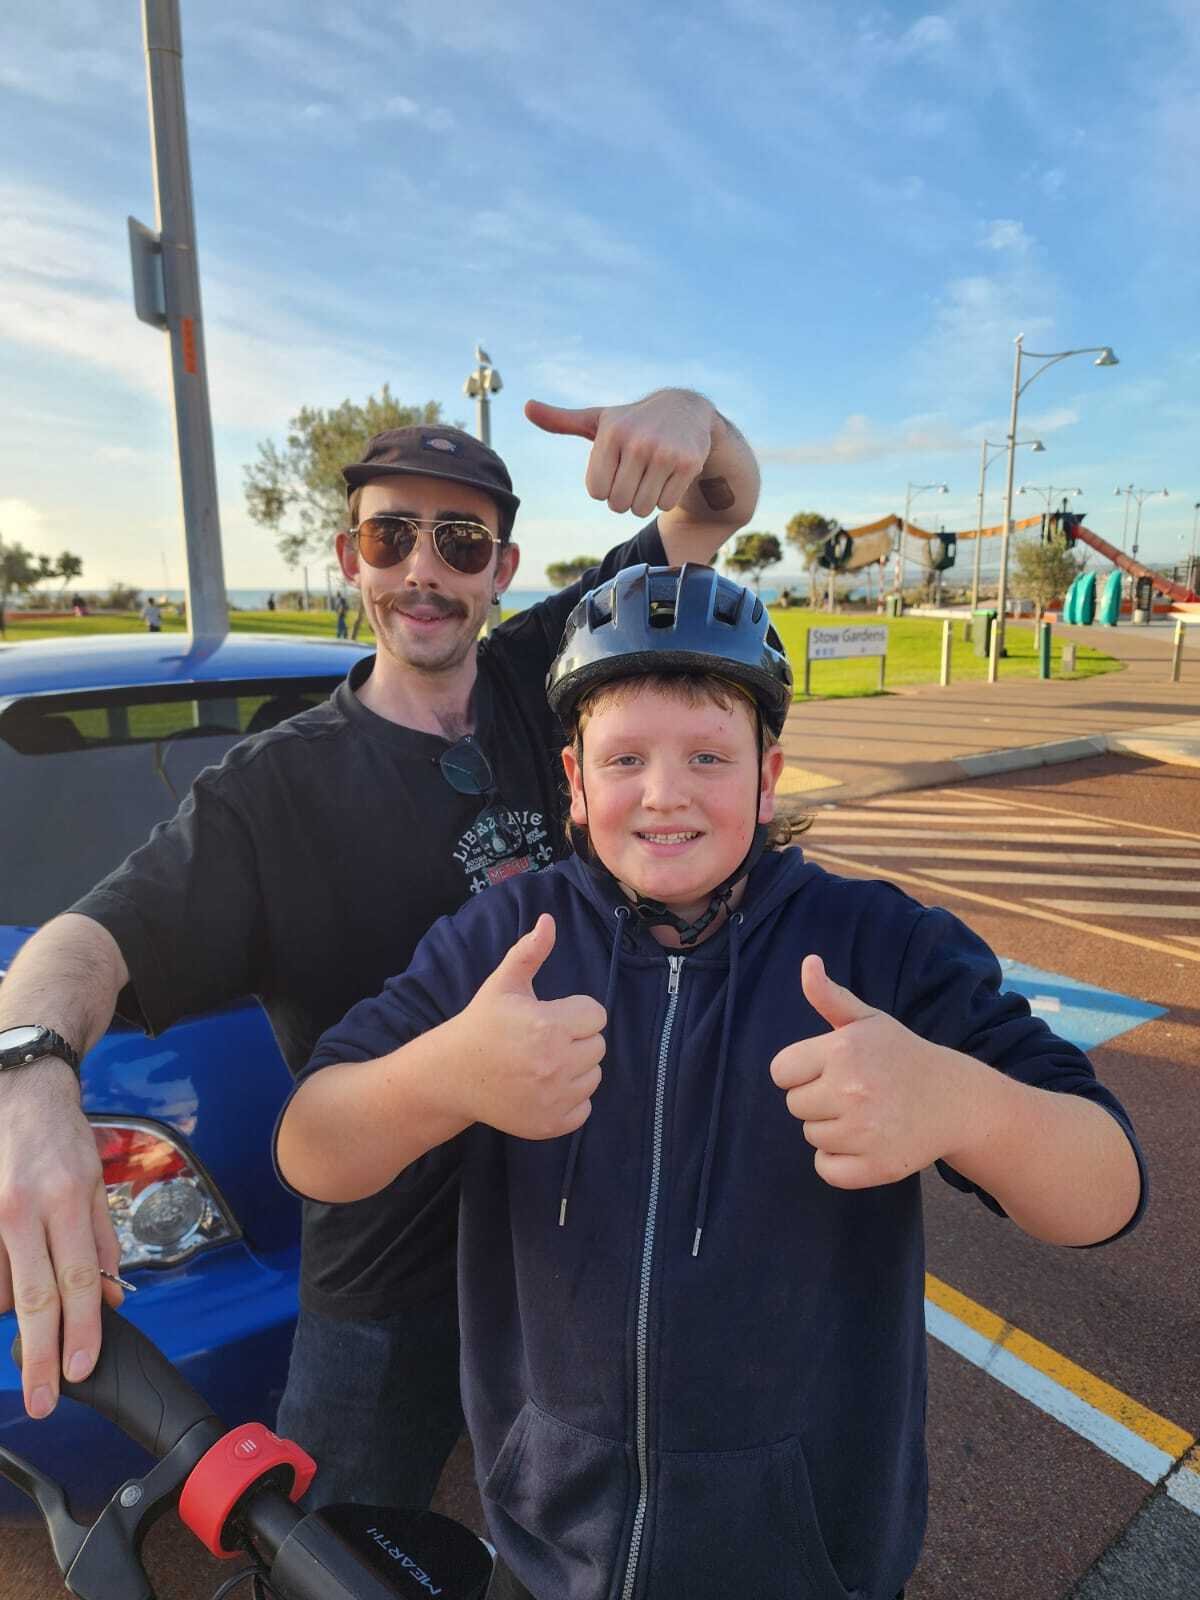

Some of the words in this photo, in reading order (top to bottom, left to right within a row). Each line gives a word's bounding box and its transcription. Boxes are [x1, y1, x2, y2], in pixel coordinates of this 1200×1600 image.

[813, 629, 839, 643] Stow
[841, 627, 885, 642] Gardens
[366, 1527, 442, 1594] MEARTH
